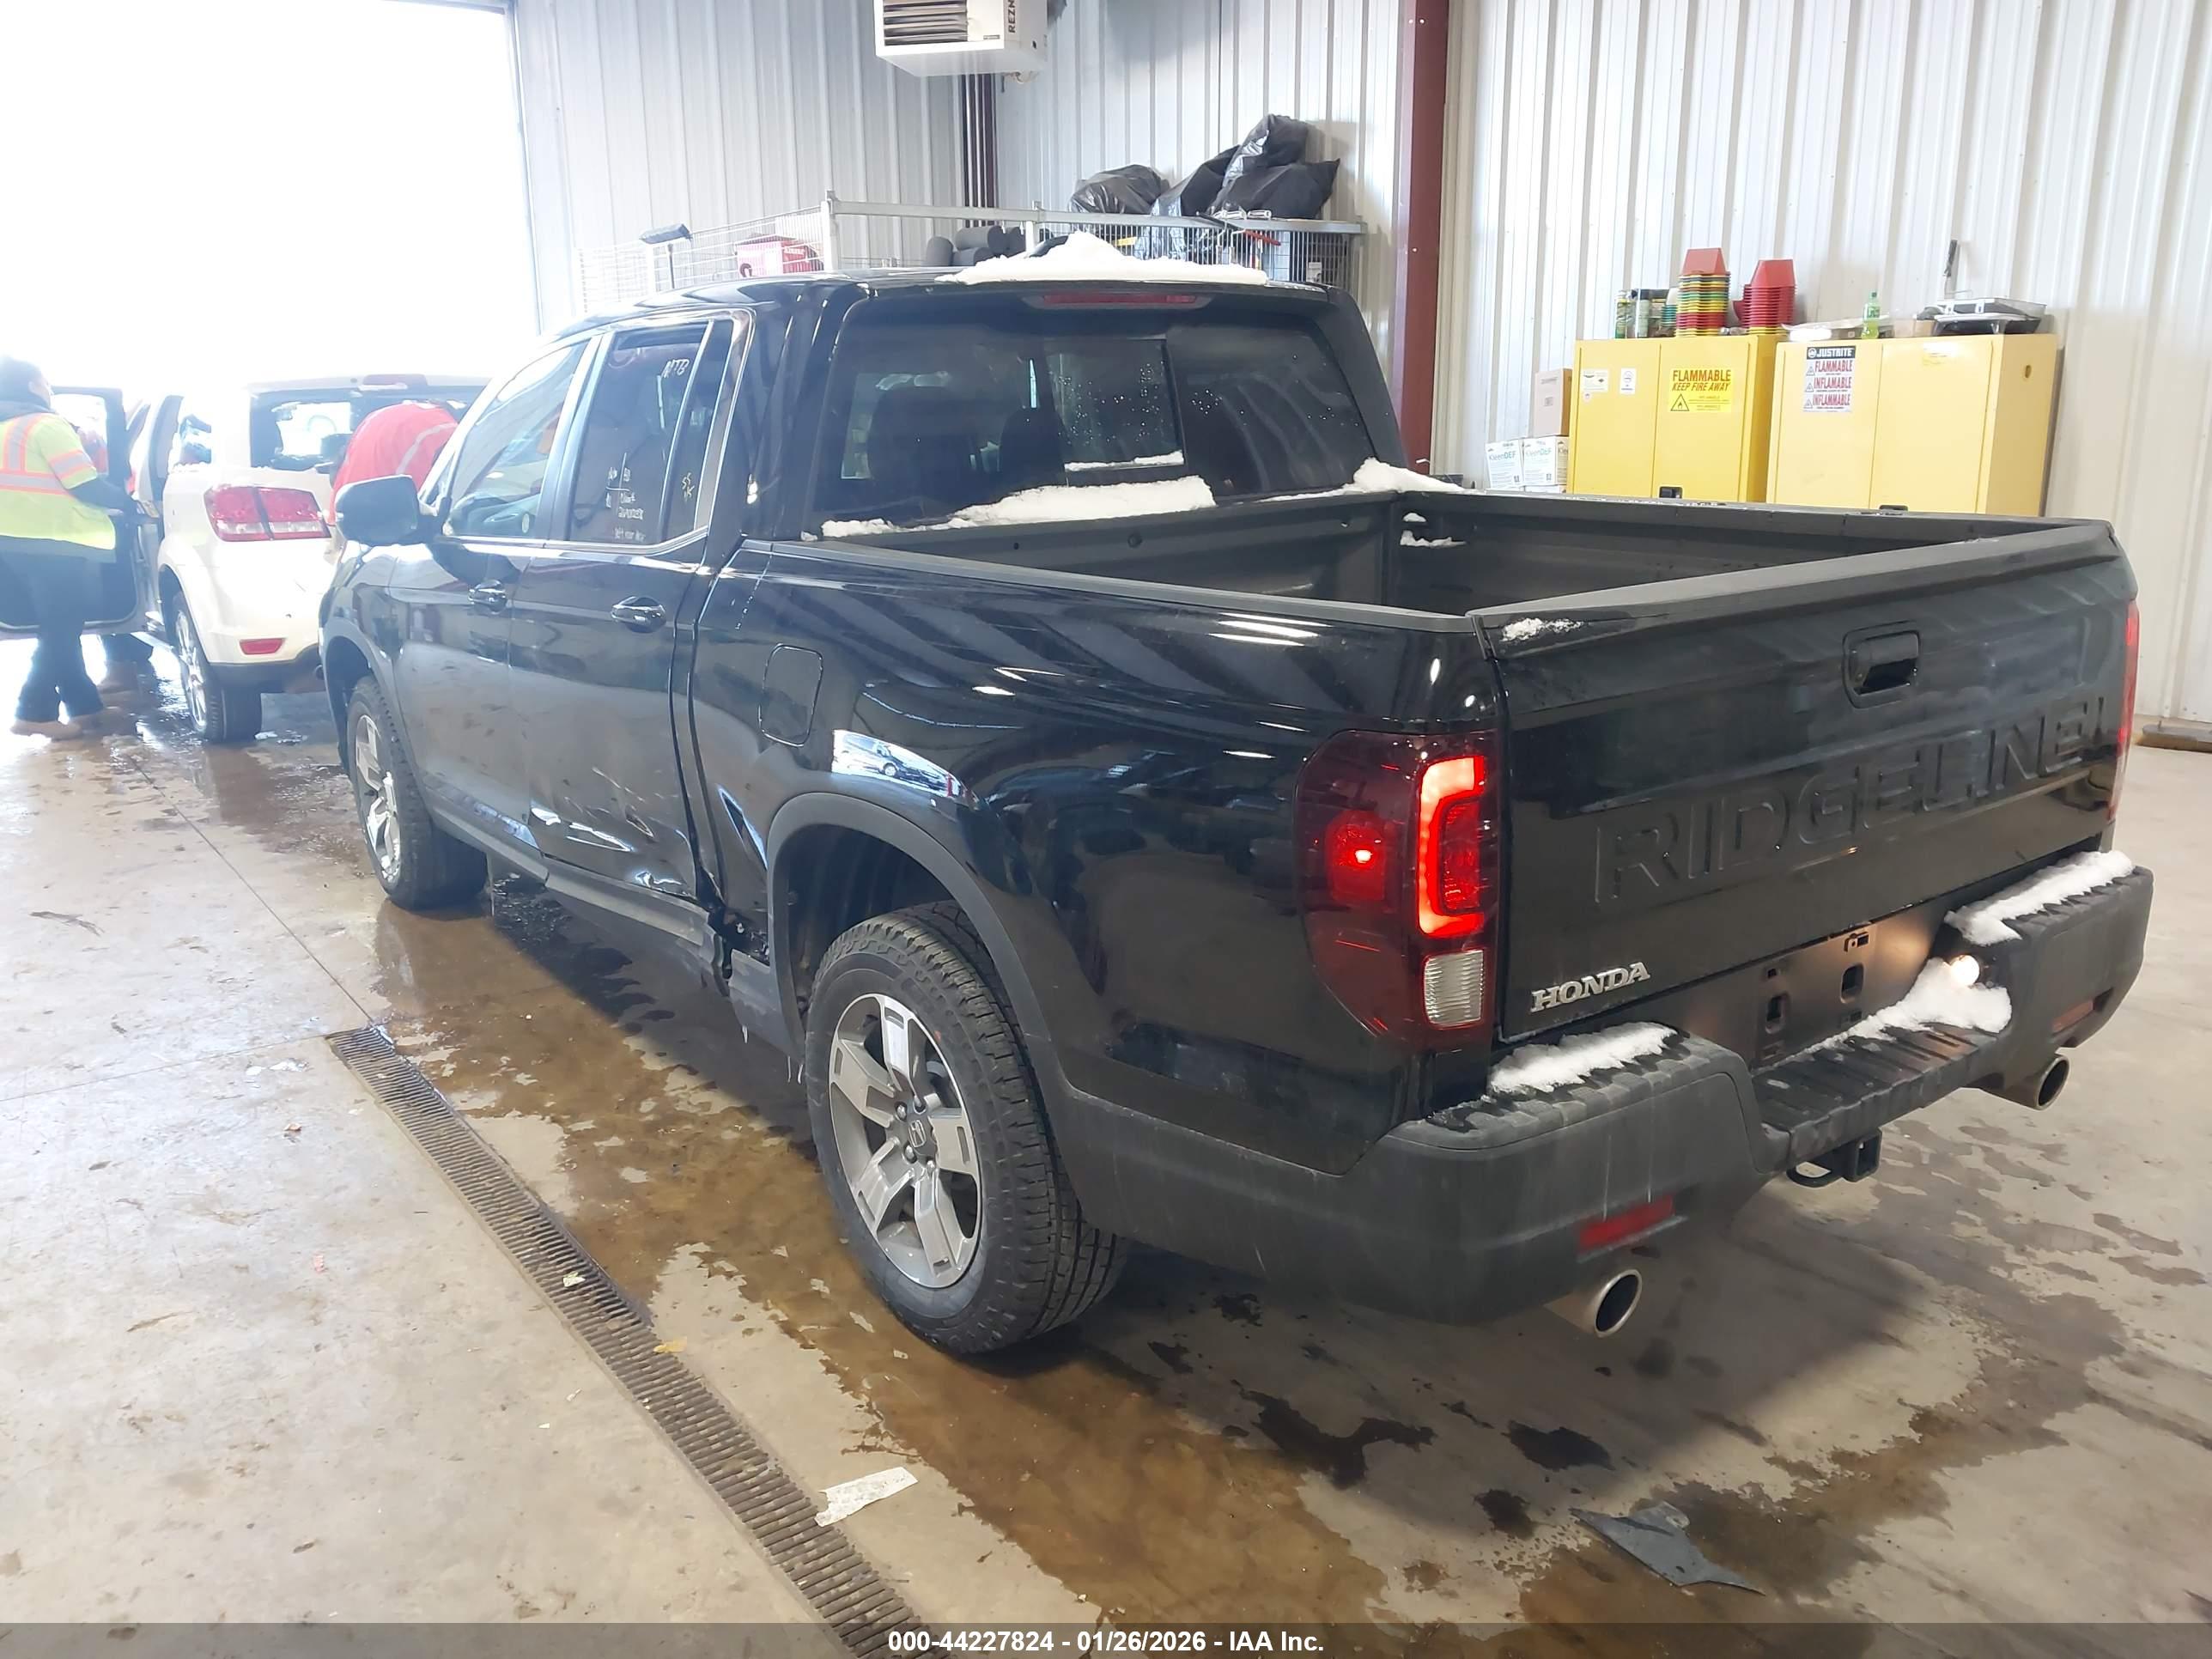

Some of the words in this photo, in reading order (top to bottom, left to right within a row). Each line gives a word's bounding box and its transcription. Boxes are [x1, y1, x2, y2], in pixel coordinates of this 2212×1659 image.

[1817, 348, 1853, 358] JUSTRITE
[1814, 360, 1853, 372] FLAMMABLE
[1673, 369, 1732, 381] FLAMMABLE
[1672, 382, 1691, 392] KEEP
[1692, 382, 1709, 392] FIRE
[1709, 382, 1731, 392] AWAY
[1814, 377, 1852, 389] INFLAMABLE
[1812, 393, 1850, 406] INFLAMMABLE
[1595, 700, 2089, 904] RIDGELINE
[1530, 962, 1650, 1013] HONDA
